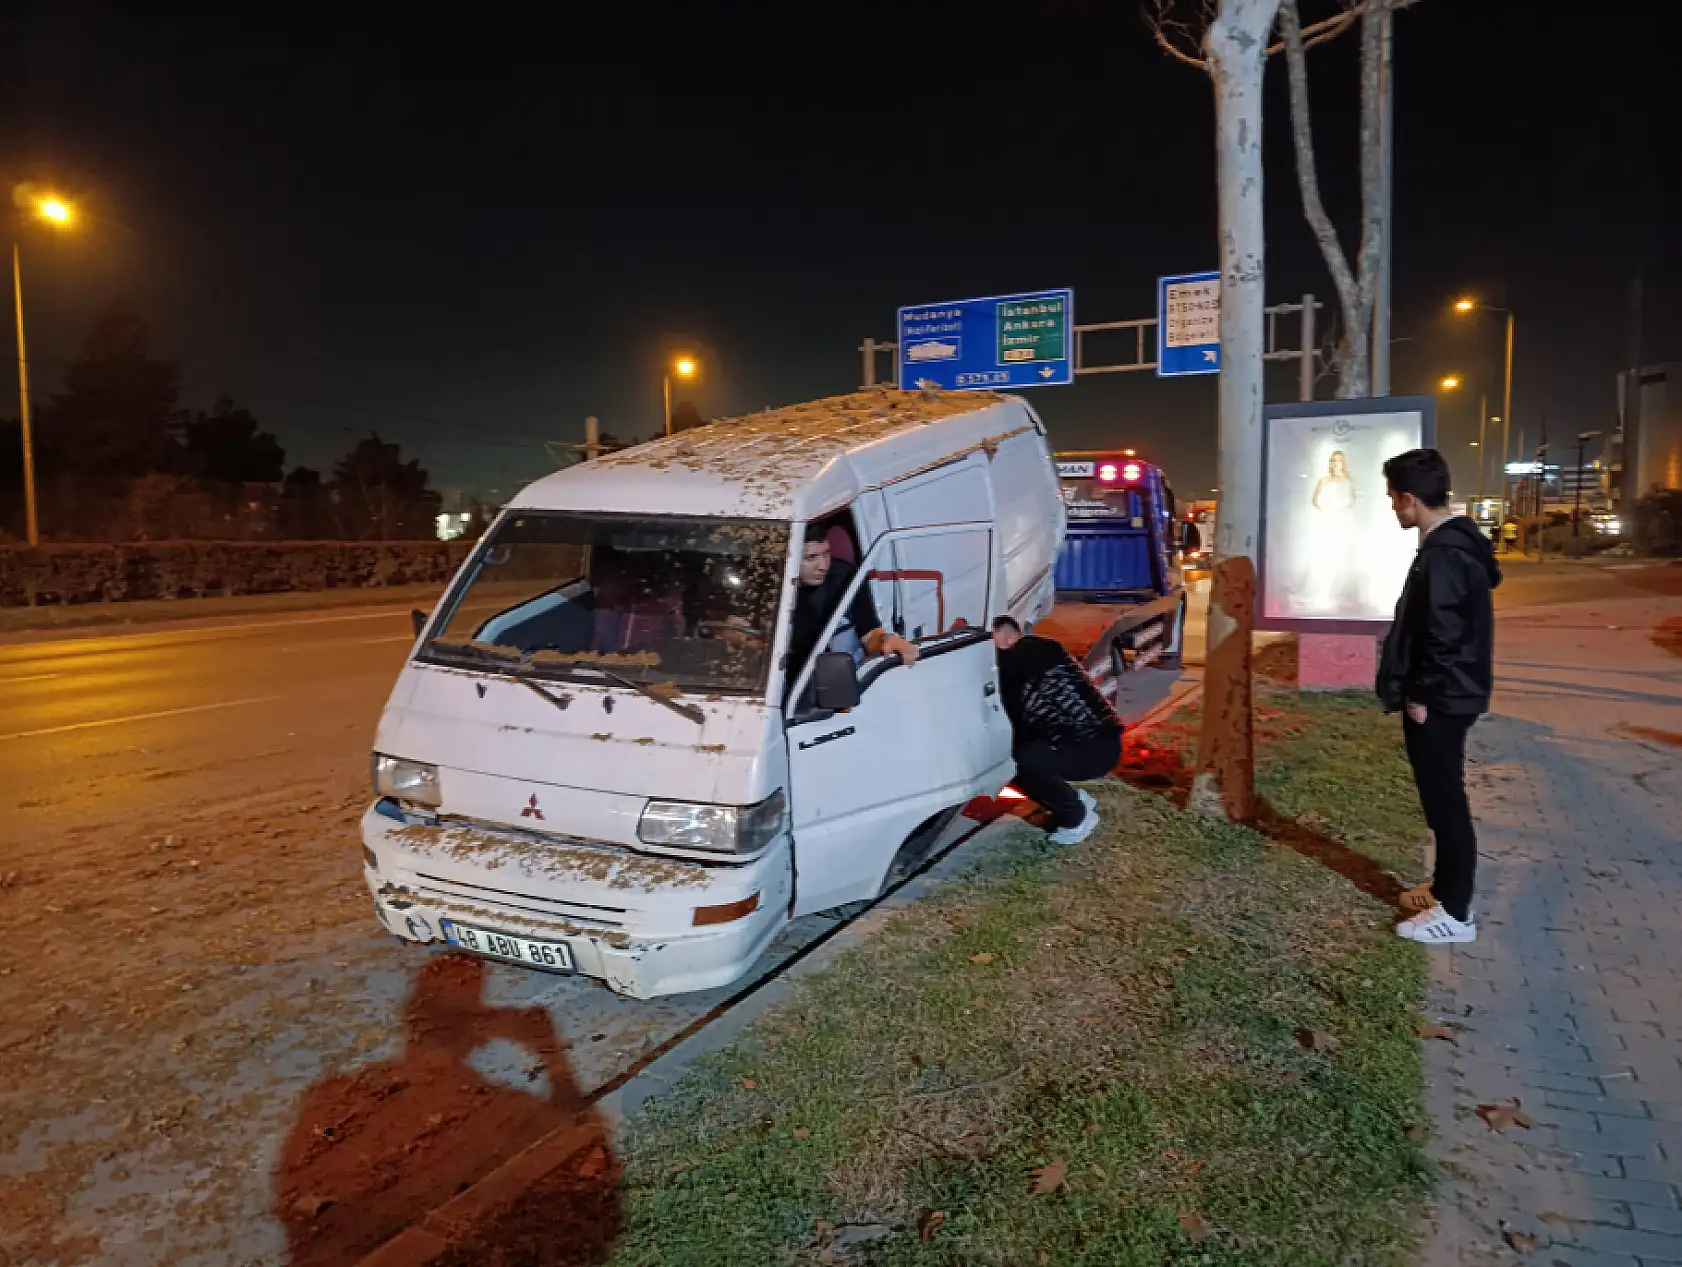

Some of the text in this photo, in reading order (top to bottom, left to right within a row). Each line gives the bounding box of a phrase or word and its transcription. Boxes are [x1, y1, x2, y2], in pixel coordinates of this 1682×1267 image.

[1169, 286, 1211, 300] Emek
[903, 309, 961, 321] Mudanya
[1003, 319, 1055, 332] Ankara
[798, 725, 856, 750] L300
[456, 926, 567, 967] 48 ABU 861
